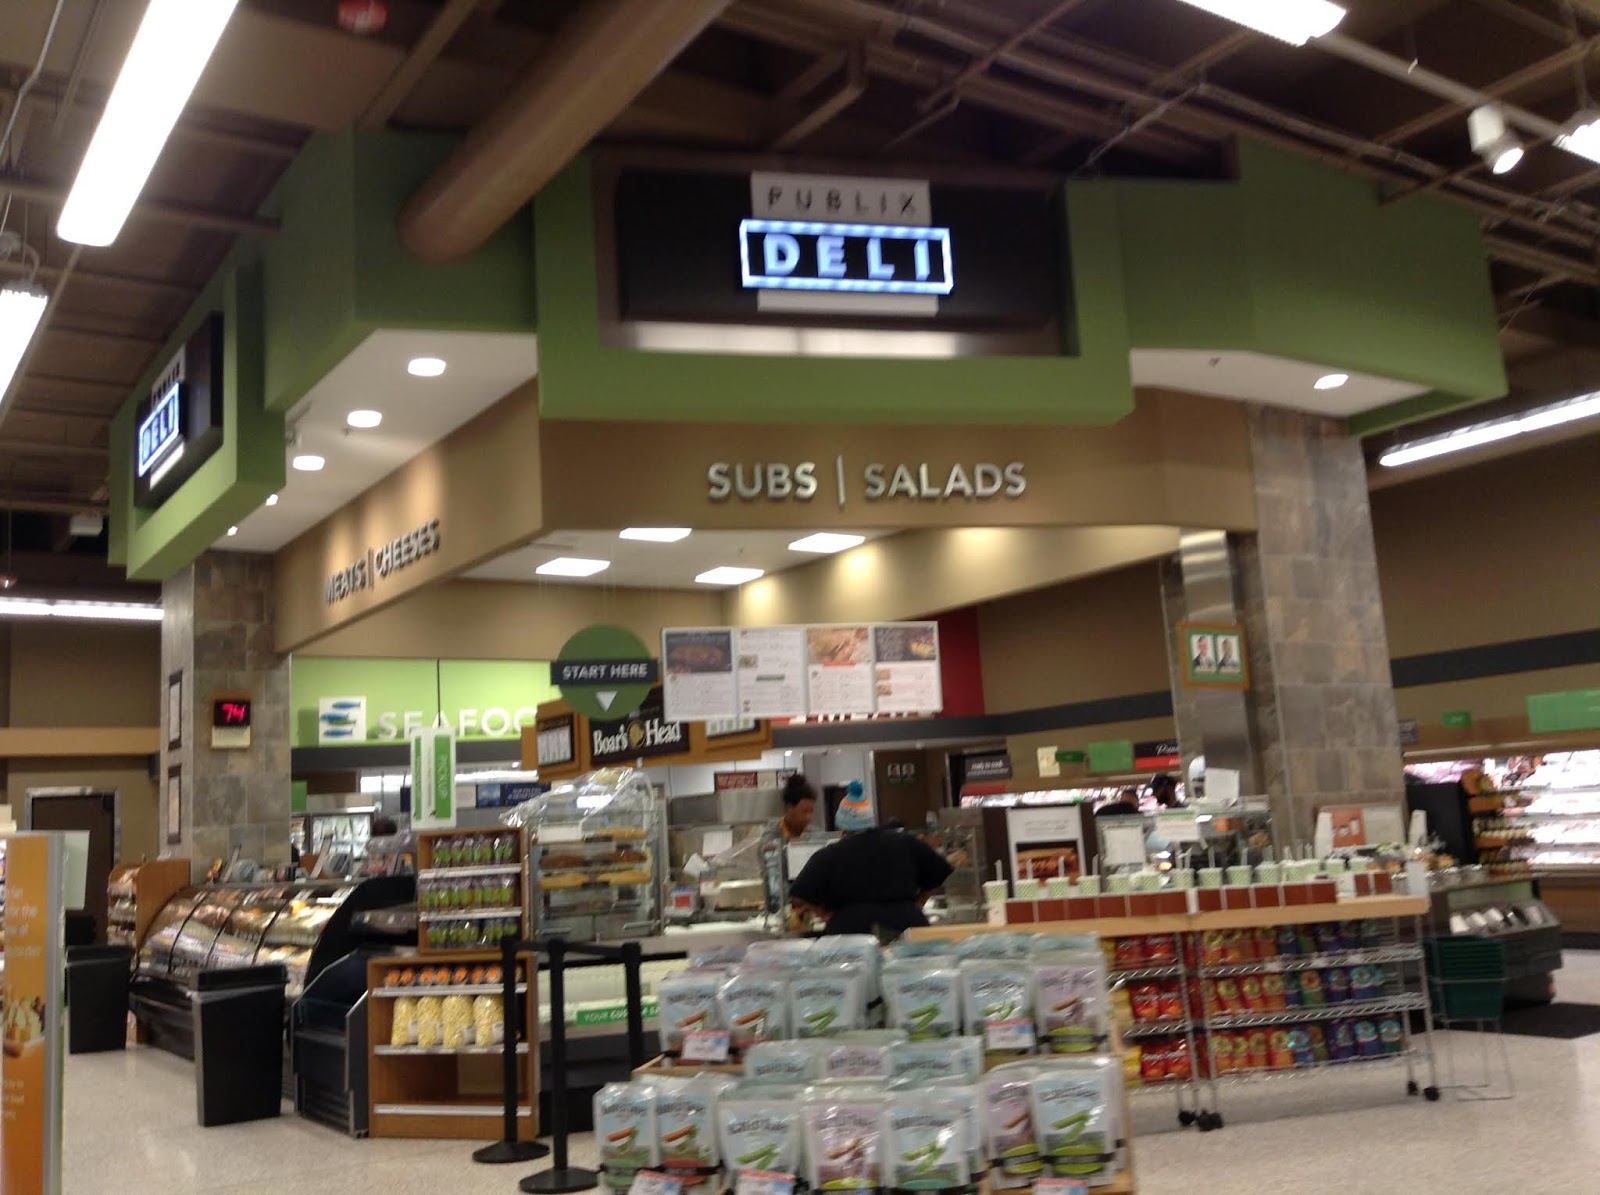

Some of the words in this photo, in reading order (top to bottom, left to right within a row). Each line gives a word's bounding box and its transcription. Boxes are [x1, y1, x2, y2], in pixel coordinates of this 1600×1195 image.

[767, 186, 917, 216] PUBLIX
[763, 232, 931, 281] DELI
[142, 395, 175, 465] DELI
[707, 462, 818, 500] SUBS
[863, 461, 1027, 499] SALADS
[325, 559, 366, 606] MEATS
[374, 518, 440, 578] CHEESES
[562, 664, 607, 680] START
[610, 663, 648, 679] HERE
[593, 723, 628, 756] Boar's
[645, 717, 682, 747] Head
